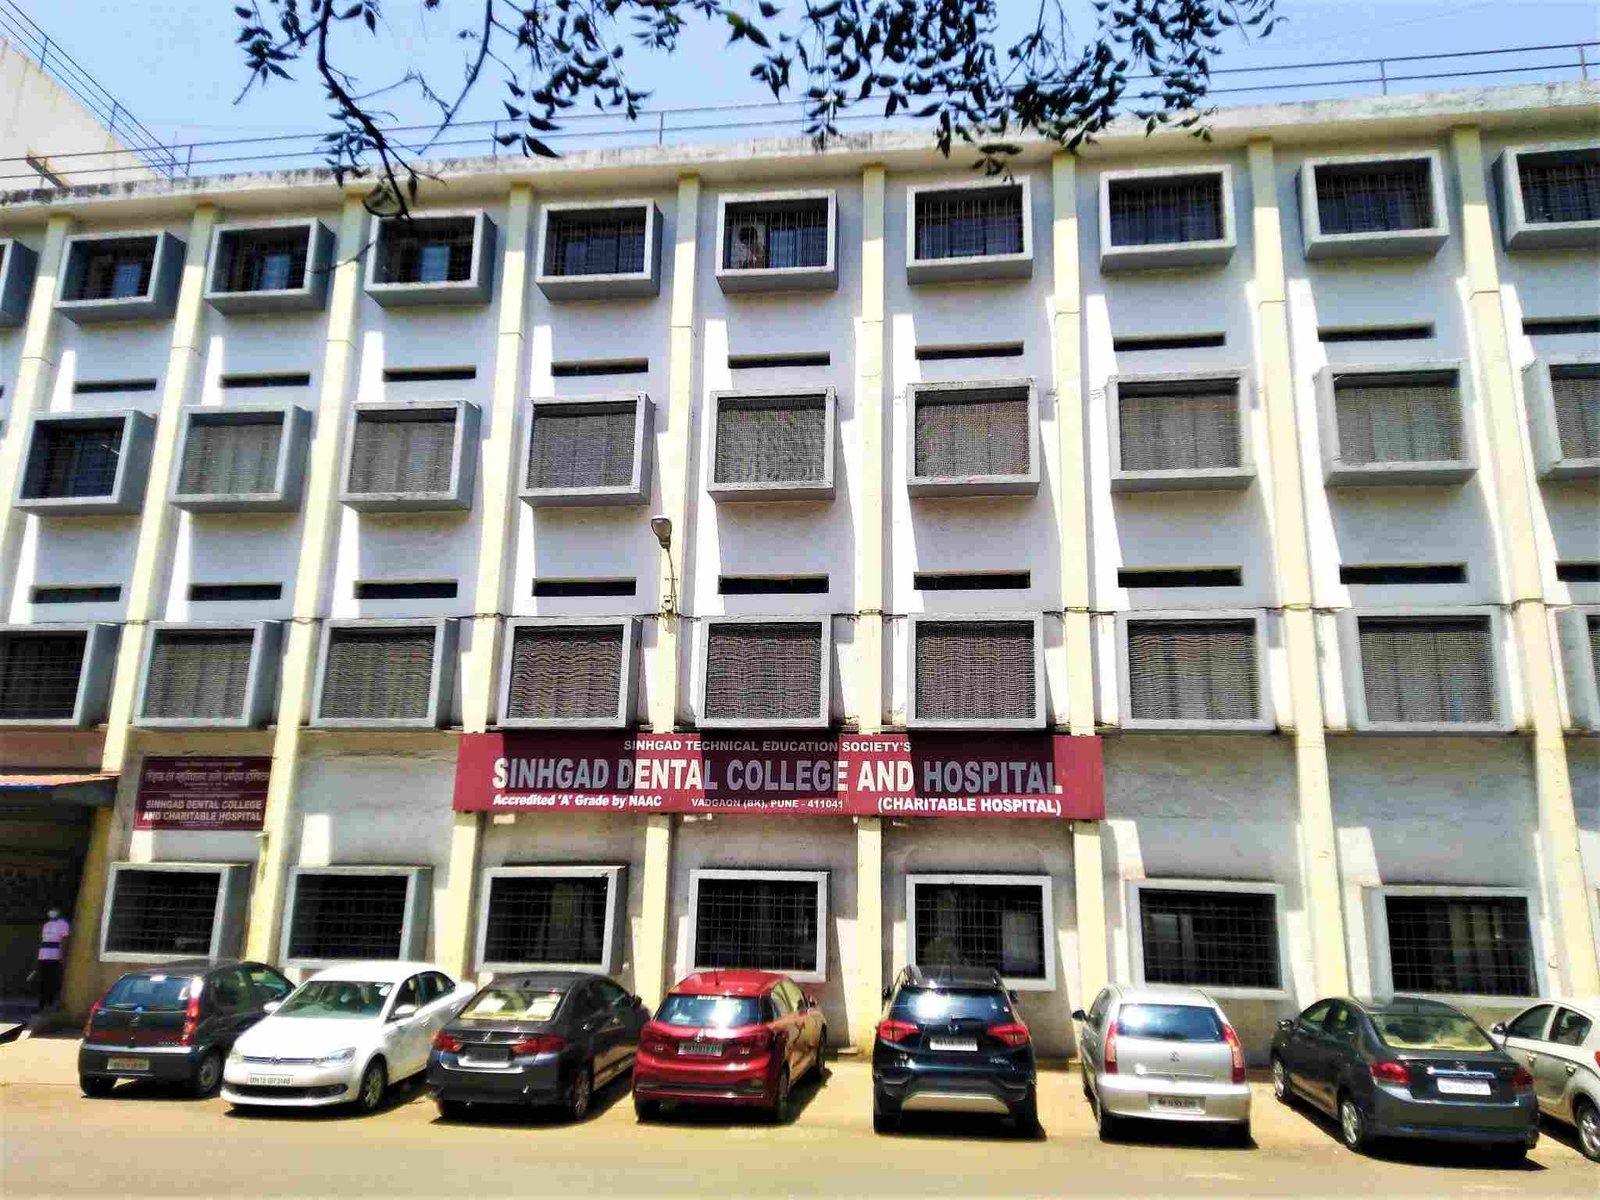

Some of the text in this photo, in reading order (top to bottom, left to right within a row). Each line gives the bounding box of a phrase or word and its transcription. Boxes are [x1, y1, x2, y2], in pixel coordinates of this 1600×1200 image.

[624, 740, 912, 752] SINHGAD TECHNICAL EDUCATION SOCIETY'S
[492, 757, 1063, 794] SINHGAD DENTAL COLLEGE AND HOSPITAL
[145, 799, 263, 809] SINHGAD DENTAL COLLEGE
[493, 794, 556, 806] Accredited
[575, 794, 609, 806] Grade
[612, 795, 626, 809] by
[629, 795, 662, 807] NAAC
[691, 798, 741, 807] VADGAON
[770, 799, 799, 809] PUNE
[807, 799, 843, 809] 411041
[878, 797, 1062, 816] (CHARITABLE HOSPITAL)
[142, 811, 262, 821] AND CHARITABLE HOSPITAL
